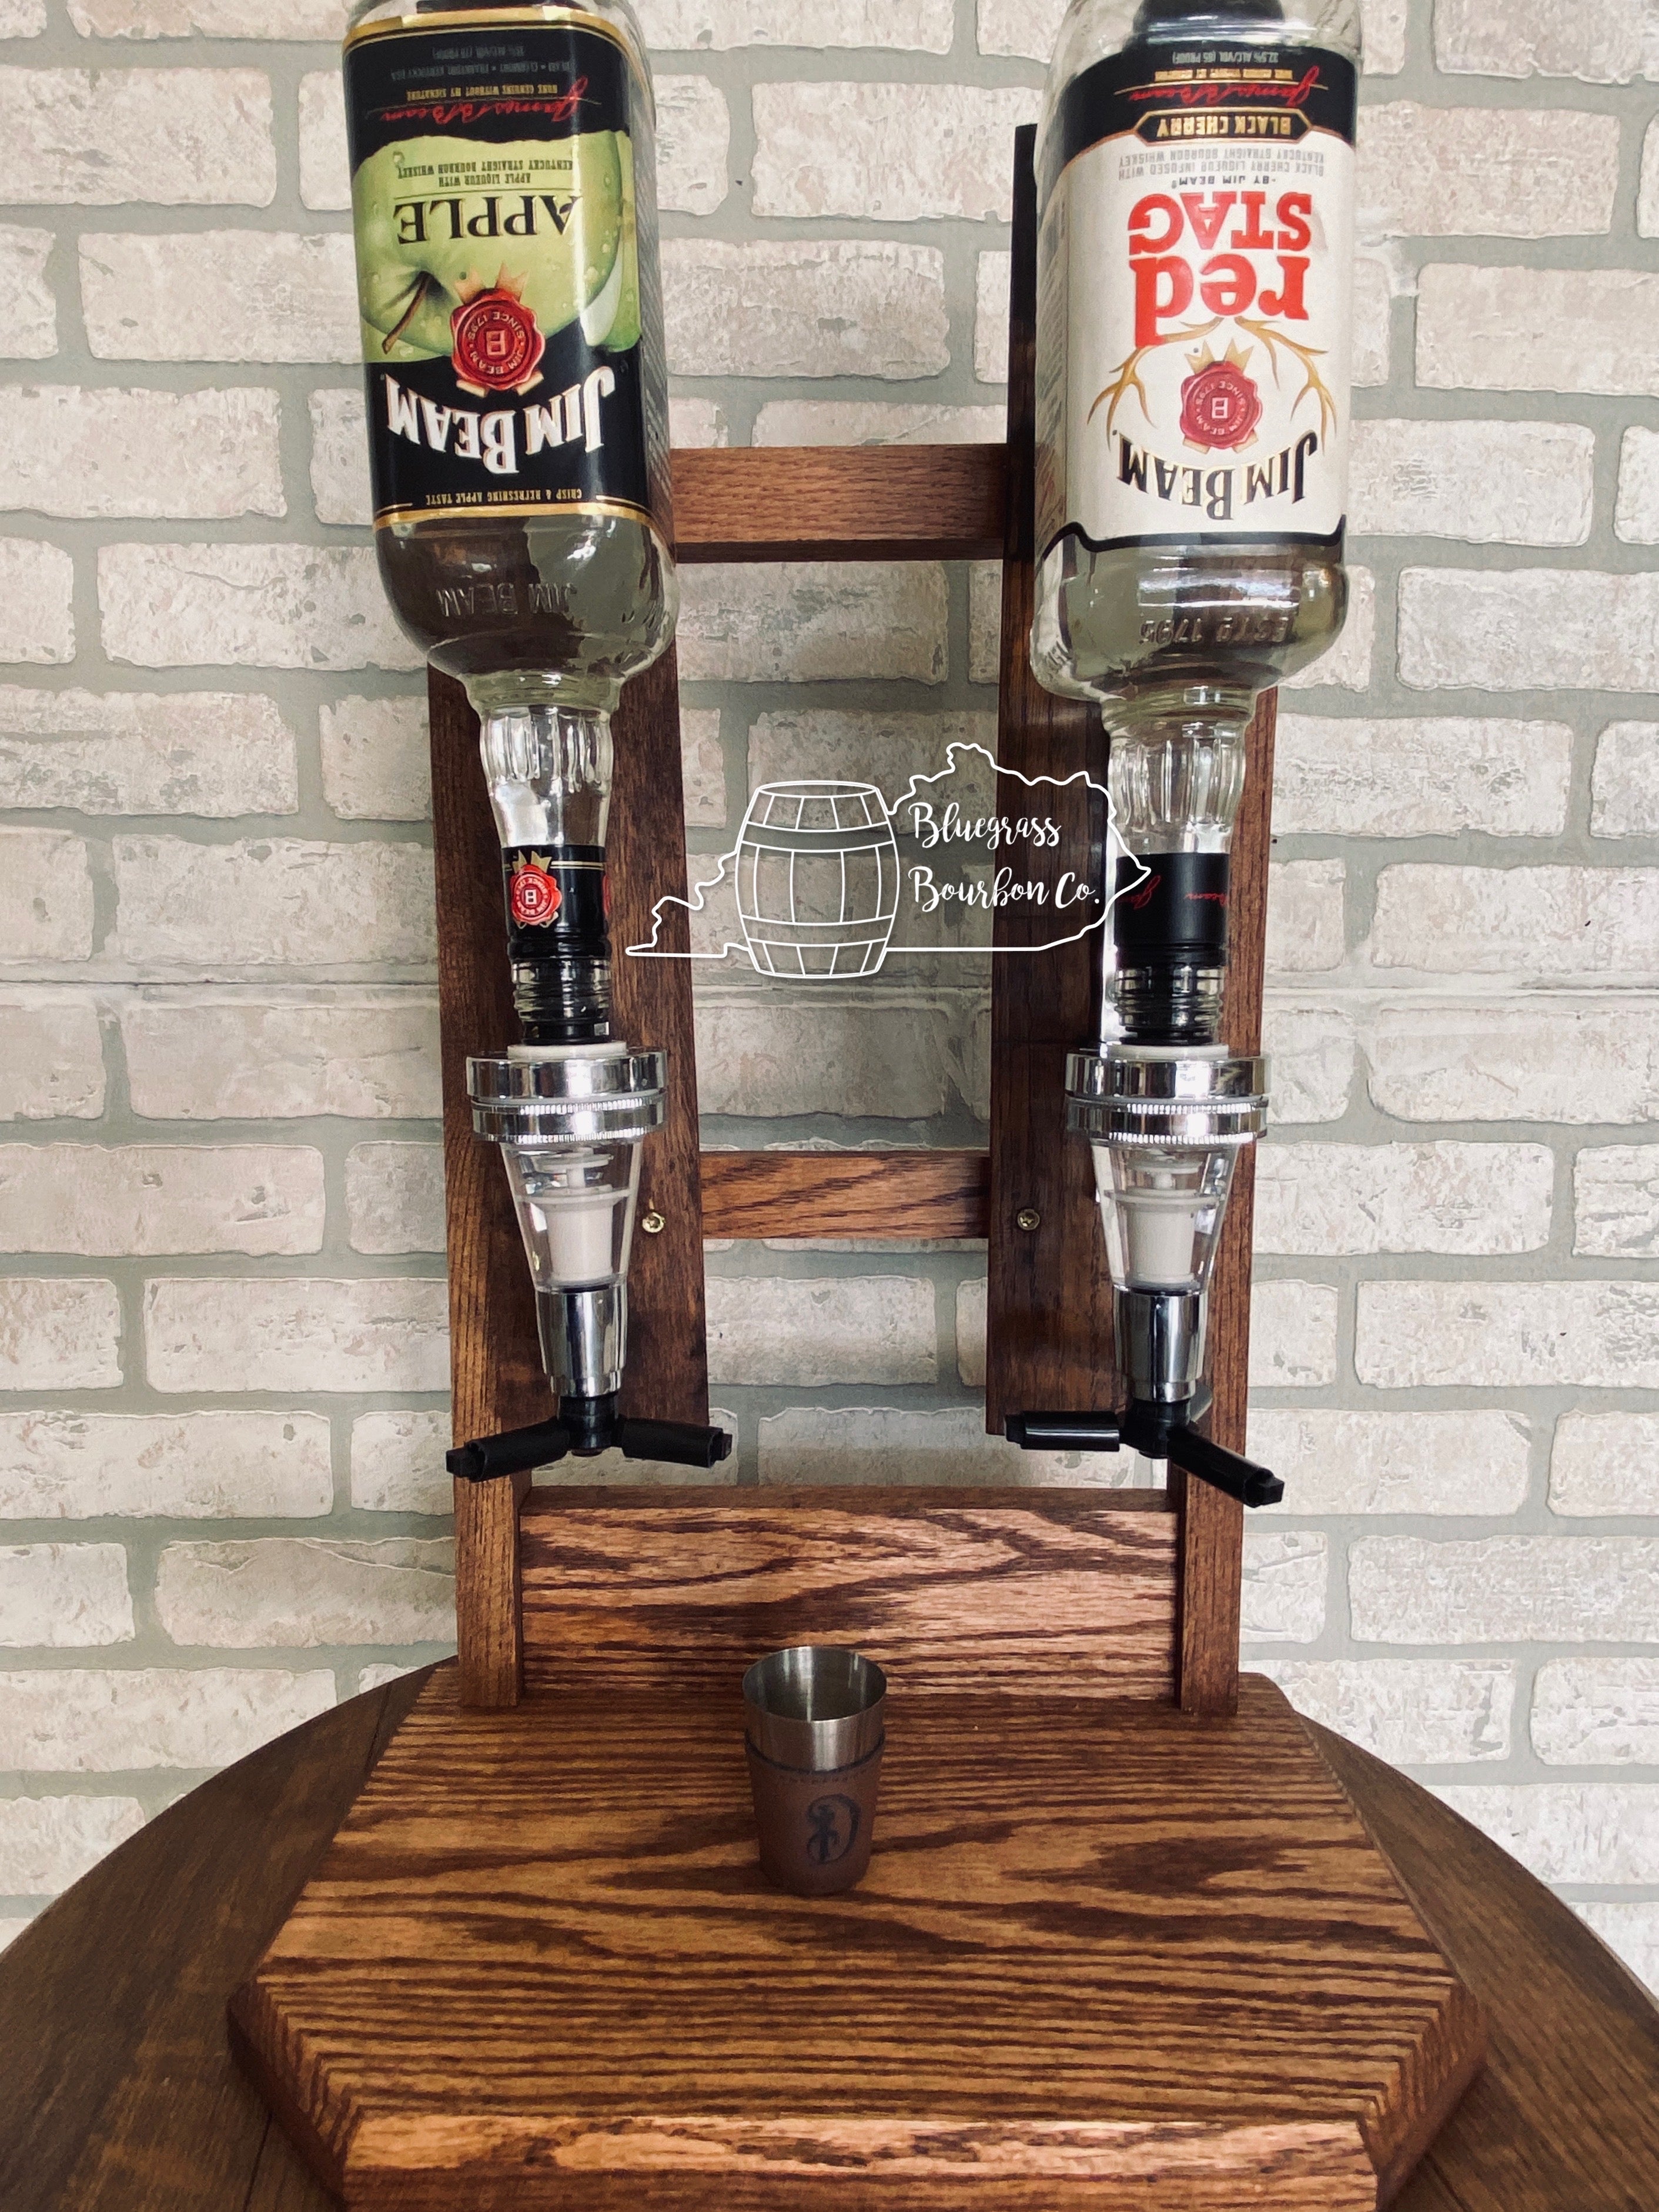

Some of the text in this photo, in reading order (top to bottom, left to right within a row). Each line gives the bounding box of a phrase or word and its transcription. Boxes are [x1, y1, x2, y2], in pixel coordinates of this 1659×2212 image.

[1156, 115, 1292, 138] BLACK CHERRY
[1118, 152, 1165, 168] WHISKEY
[1170, 149, 1218, 160] BOURBON
[1224, 148, 1271, 159] STRAIGHT
[398, 160, 573, 179] KENTUCKY STRAIGHT BOURBON WHISKEY
[439, 173, 530, 187] APPLE LIQUEUR WITH
[1118, 160, 1324, 180] BLACK CHERRY LIQUEUR INFUSED WITH
[1223, 175, 1246, 185] JIM
[393, 195, 583, 245] APPLE
[1128, 191, 1312, 255] STAG
[1129, 254, 1310, 349] red
[493, 312, 524, 338] SINCE
[470, 351, 503, 374] BEAM
[384, 366, 615, 474] JIM BEAM
[1117, 430, 1318, 520] JIM BEAM
[426, 488, 581, 506] CRISP & REFRESHING APPLE TASTE
[436, 583, 519, 617] BEAM
